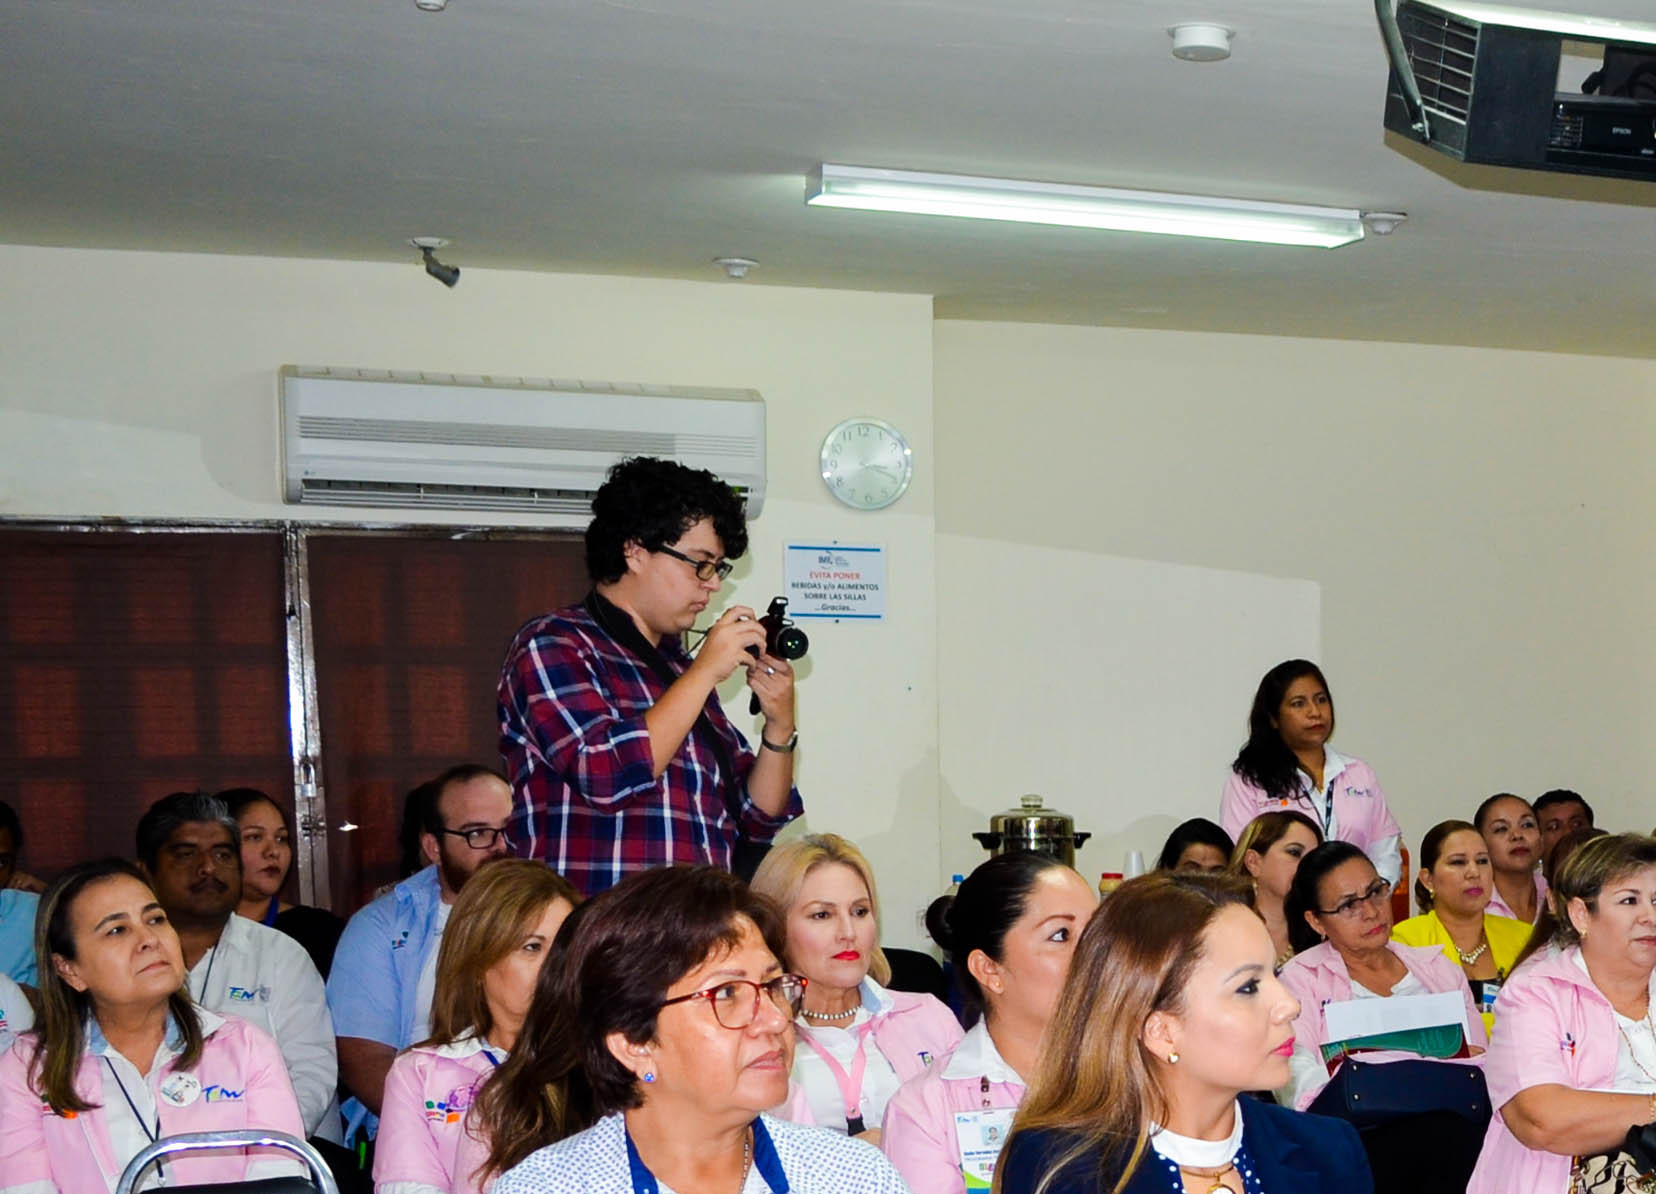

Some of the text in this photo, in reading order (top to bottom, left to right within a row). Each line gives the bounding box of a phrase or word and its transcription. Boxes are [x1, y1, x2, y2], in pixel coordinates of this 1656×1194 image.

[857, 425, 870, 437] 12
[809, 571, 861, 580] EVITA PONER
[791, 582, 822, 590] BEBIDAS
[837, 583, 879, 591] ALIMENTOS
[804, 593, 867, 601] SOBRE LAS SILLAS
